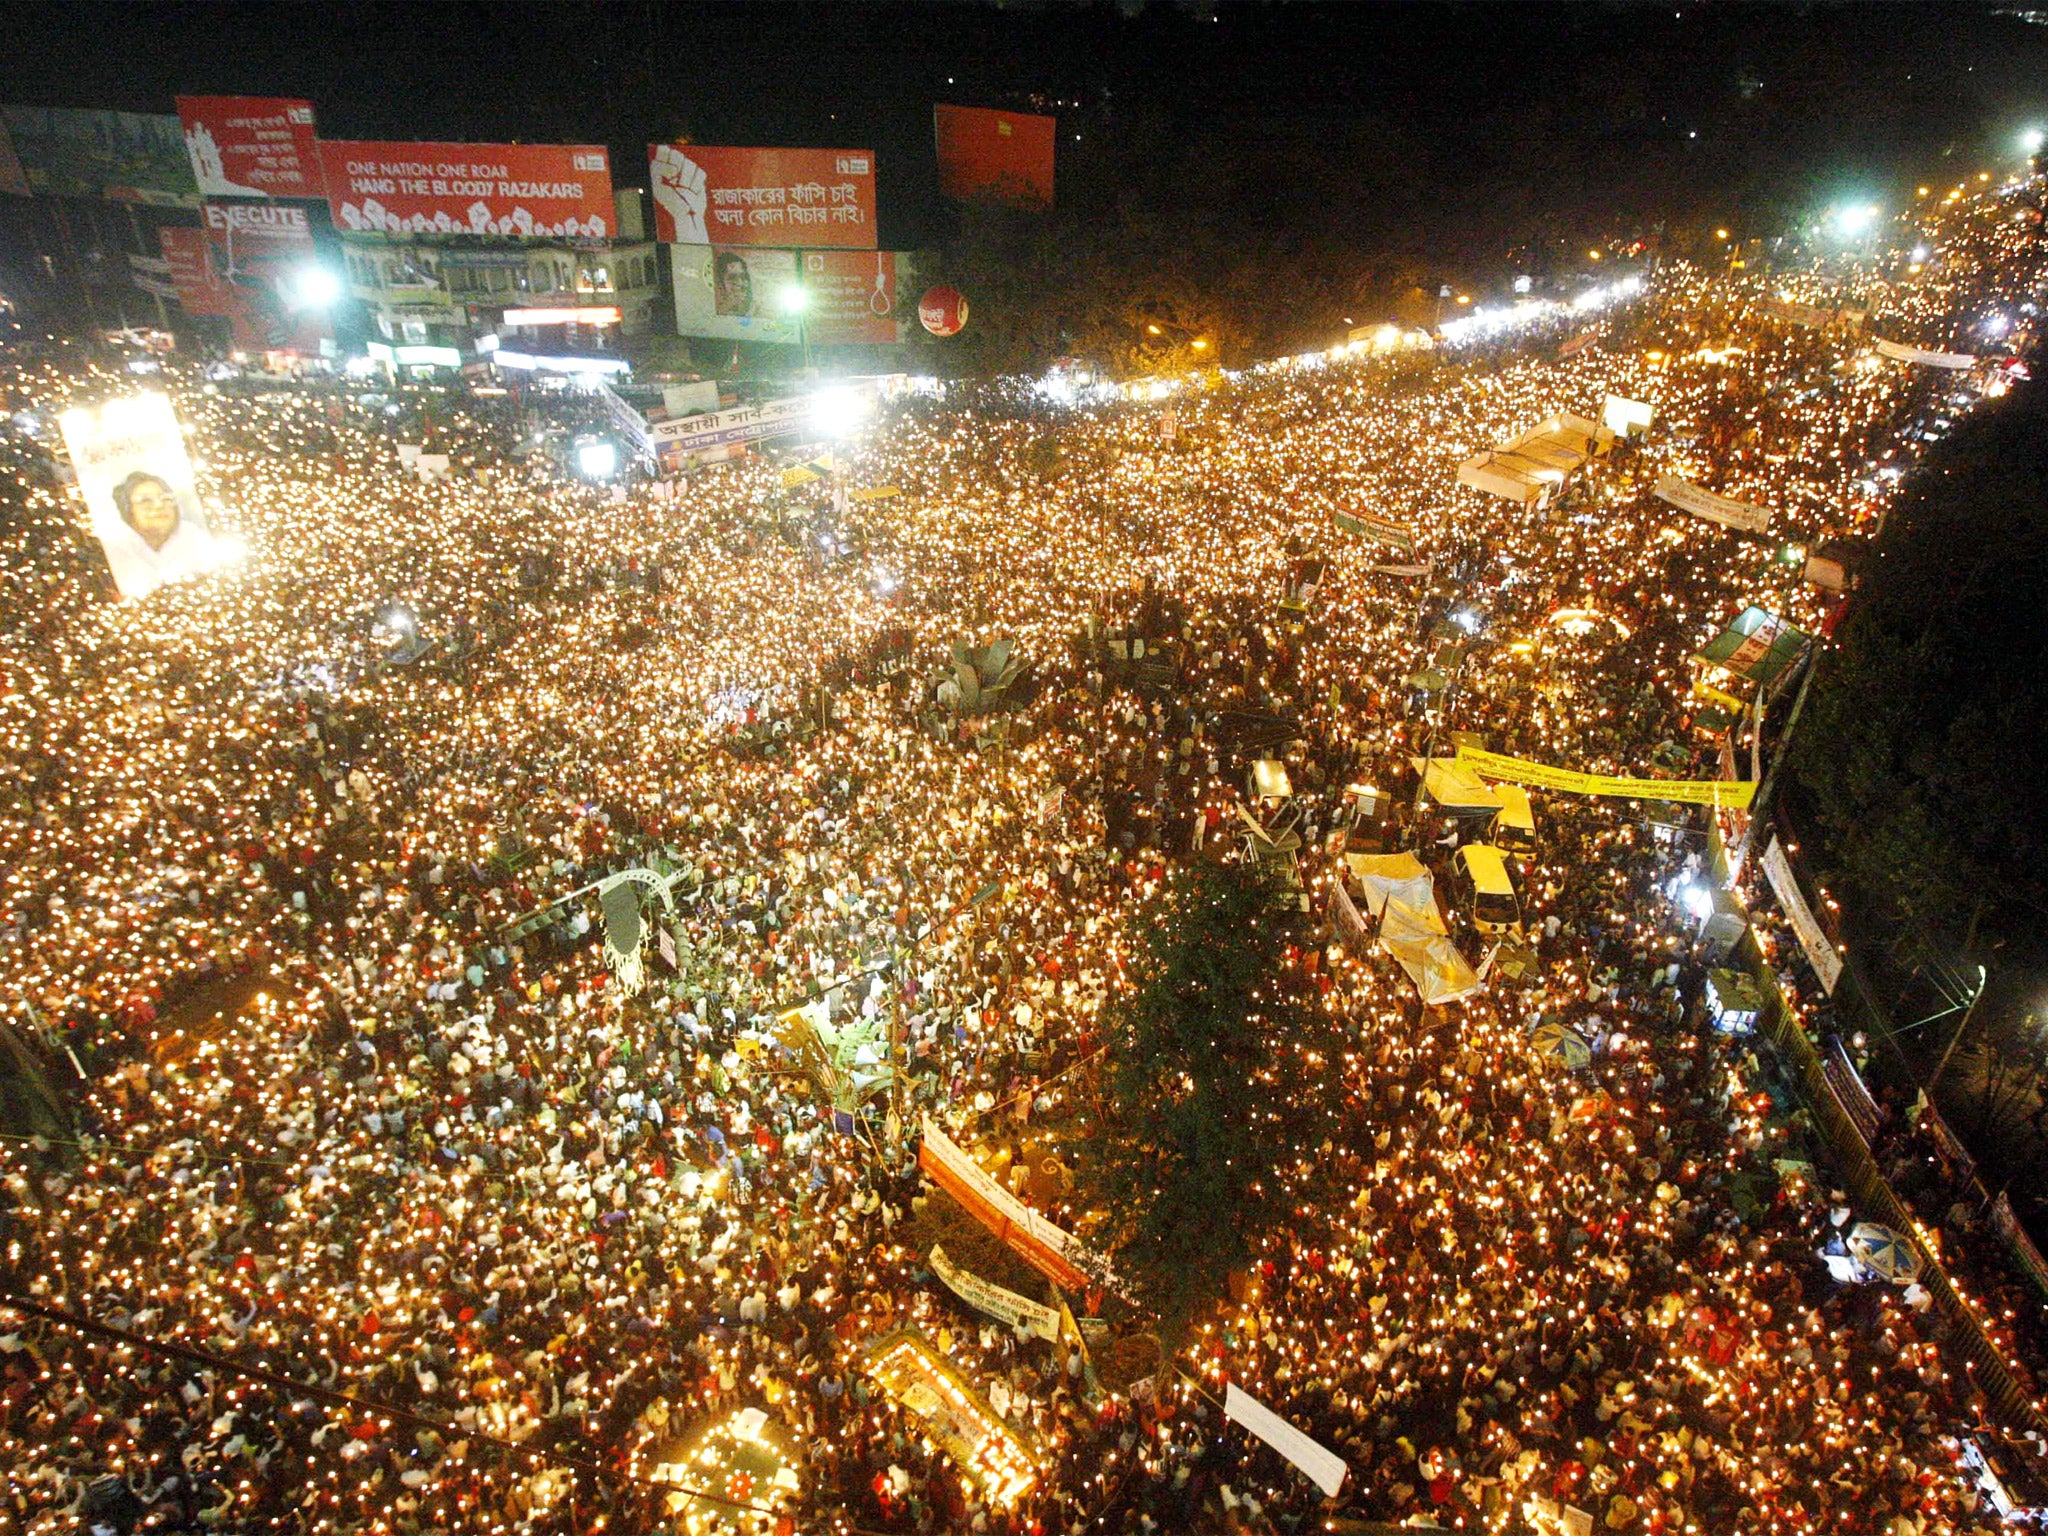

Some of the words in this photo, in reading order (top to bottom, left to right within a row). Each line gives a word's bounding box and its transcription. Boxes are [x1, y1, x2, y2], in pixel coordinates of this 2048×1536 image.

[347, 161, 376, 175] ONE
[380, 163, 433, 177] NATION
[437, 163, 467, 177] ONE
[471, 164, 508, 179] ROAR
[351, 179, 395, 194] HANG
[401, 180, 429, 195] THE
[432, 181, 494, 196] BLOODY
[499, 182, 583, 198] RAZAKARS
[711, 187, 786, 205] রাজাকারের
[789, 182, 826, 203] ফাঁসি
[829, 182, 858, 204] চাই
[206, 205, 308, 229] EXECUTE
[715, 209, 744, 226] অন্য
[749, 208, 784, 226] কোন
[787, 204, 828, 225] বিচার
